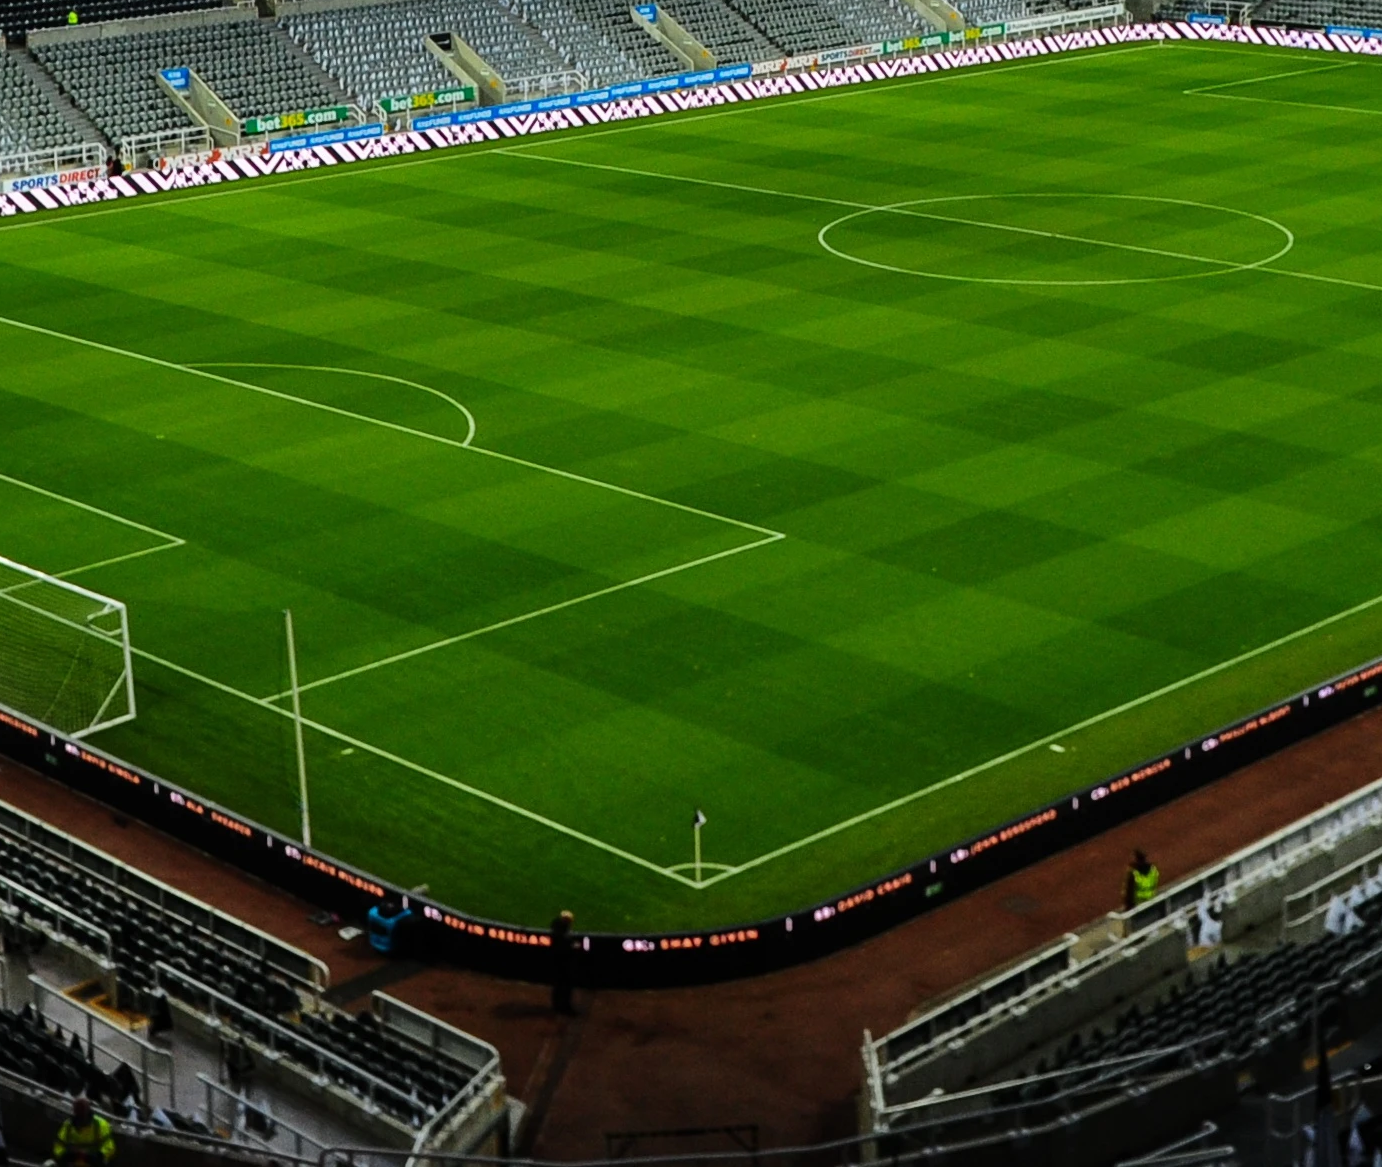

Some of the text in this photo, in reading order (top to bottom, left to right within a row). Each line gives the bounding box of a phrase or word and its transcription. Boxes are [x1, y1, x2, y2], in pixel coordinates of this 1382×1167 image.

[391, 91, 465, 110] bet365.com
[257, 111, 337, 131] bet365.com
[709, 929, 759, 947] GIVEN
